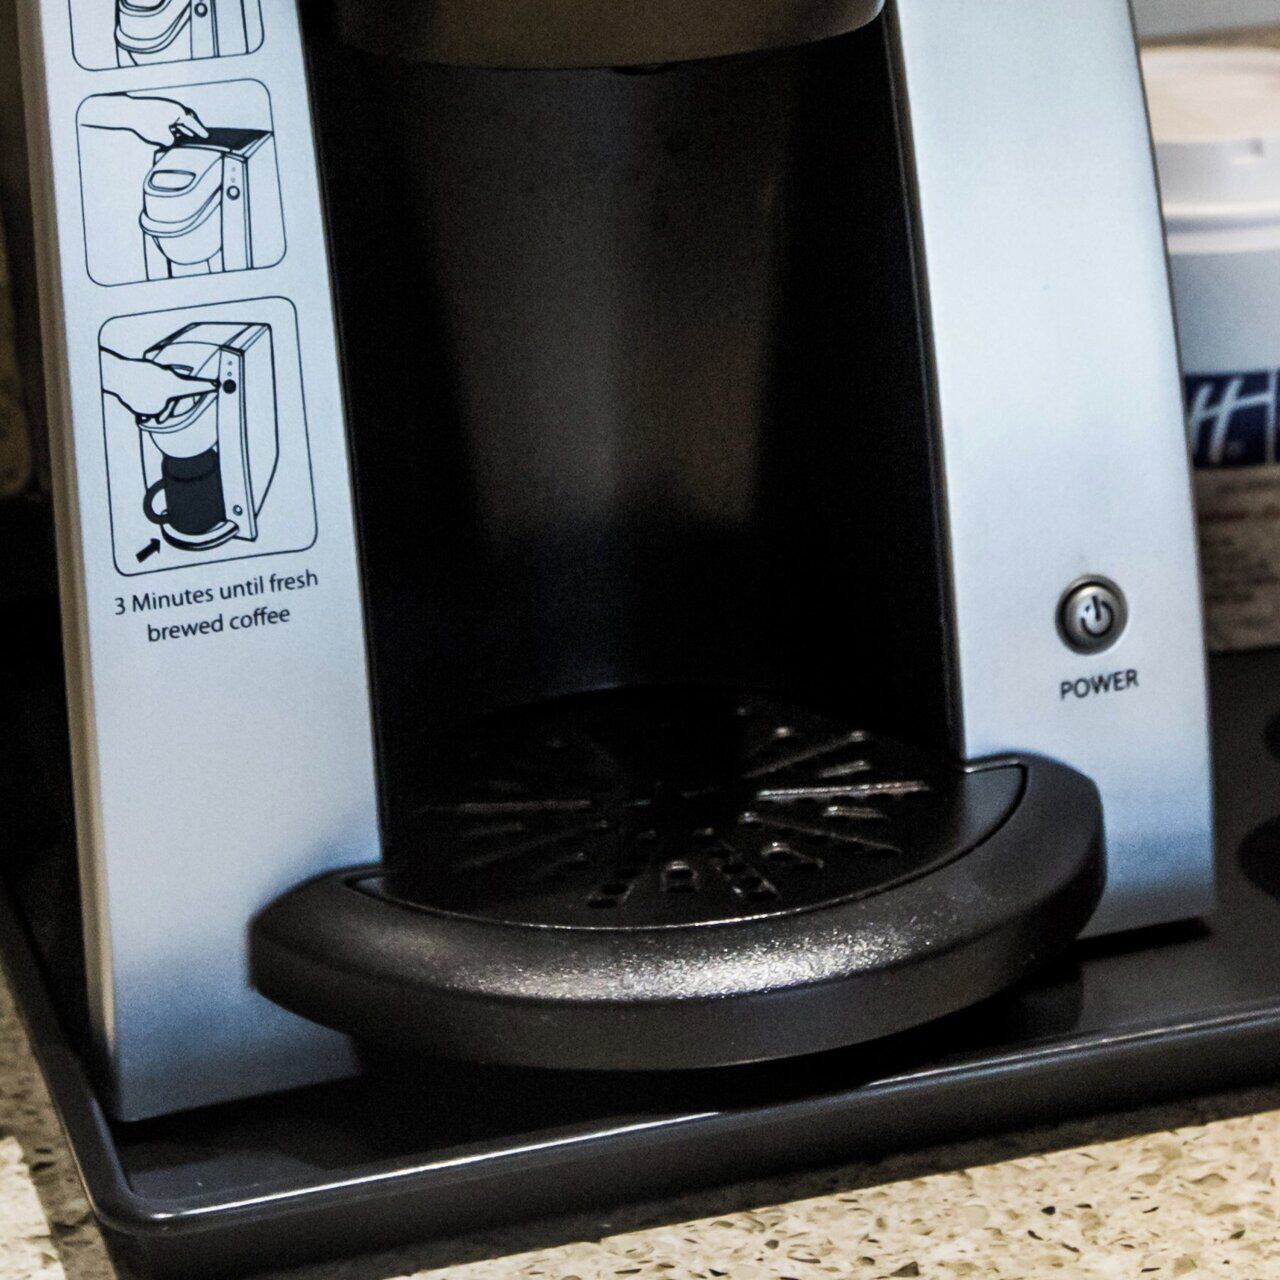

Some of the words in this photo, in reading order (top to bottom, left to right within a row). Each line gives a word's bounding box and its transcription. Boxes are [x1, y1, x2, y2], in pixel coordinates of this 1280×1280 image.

[114, 596, 126, 616] 3
[132, 586, 215, 613] Minutes
[219, 575, 265, 600] until
[269, 569, 319, 593] fresh
[146, 613, 224, 642] brewed
[229, 606, 291, 629] coffee
[1059, 668, 1140, 701] POWER
